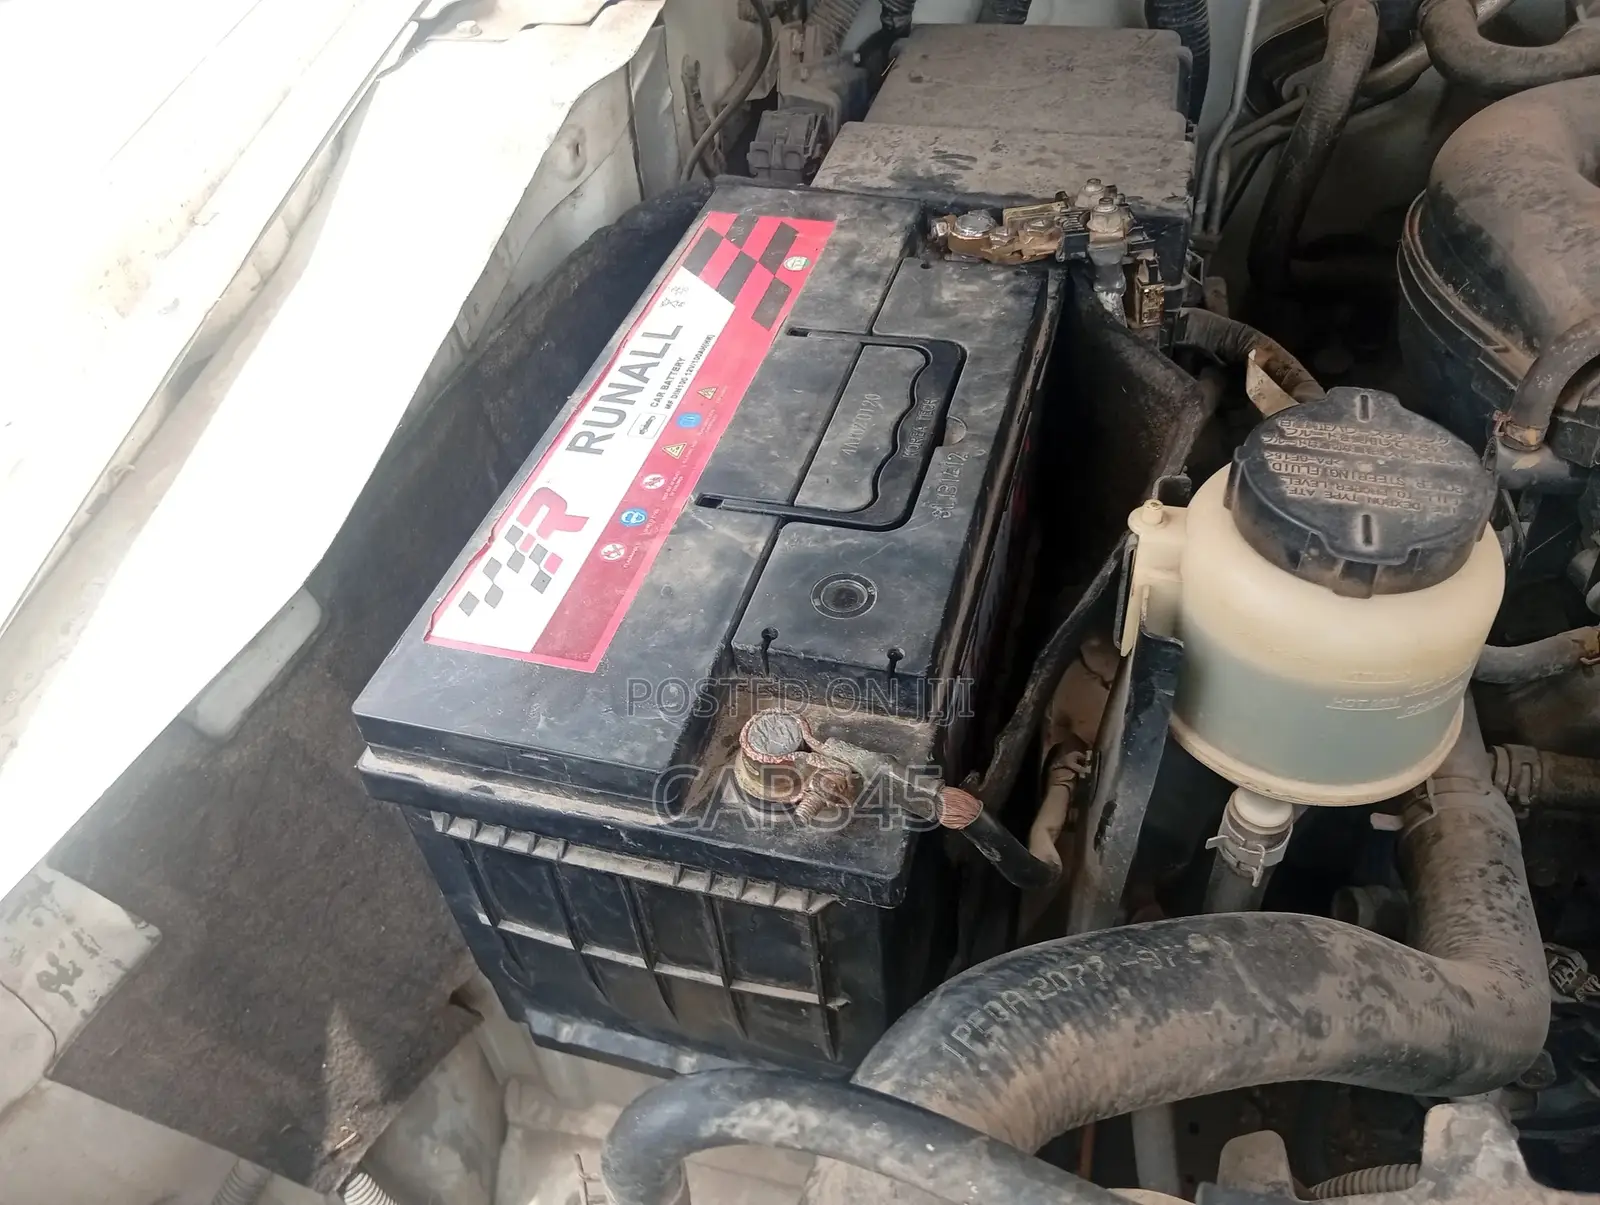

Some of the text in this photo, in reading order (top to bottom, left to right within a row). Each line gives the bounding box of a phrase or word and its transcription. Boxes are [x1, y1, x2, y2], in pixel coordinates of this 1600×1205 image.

[566, 325, 684, 455] RUNALL
[650, 357, 686, 408] CAR BATTERY
[902, 424, 928, 458] KOREA
[1329, 469, 1405, 487] STEERING
[1323, 490, 1357, 503] TYPE
[1396, 488, 1412, 500] TO
